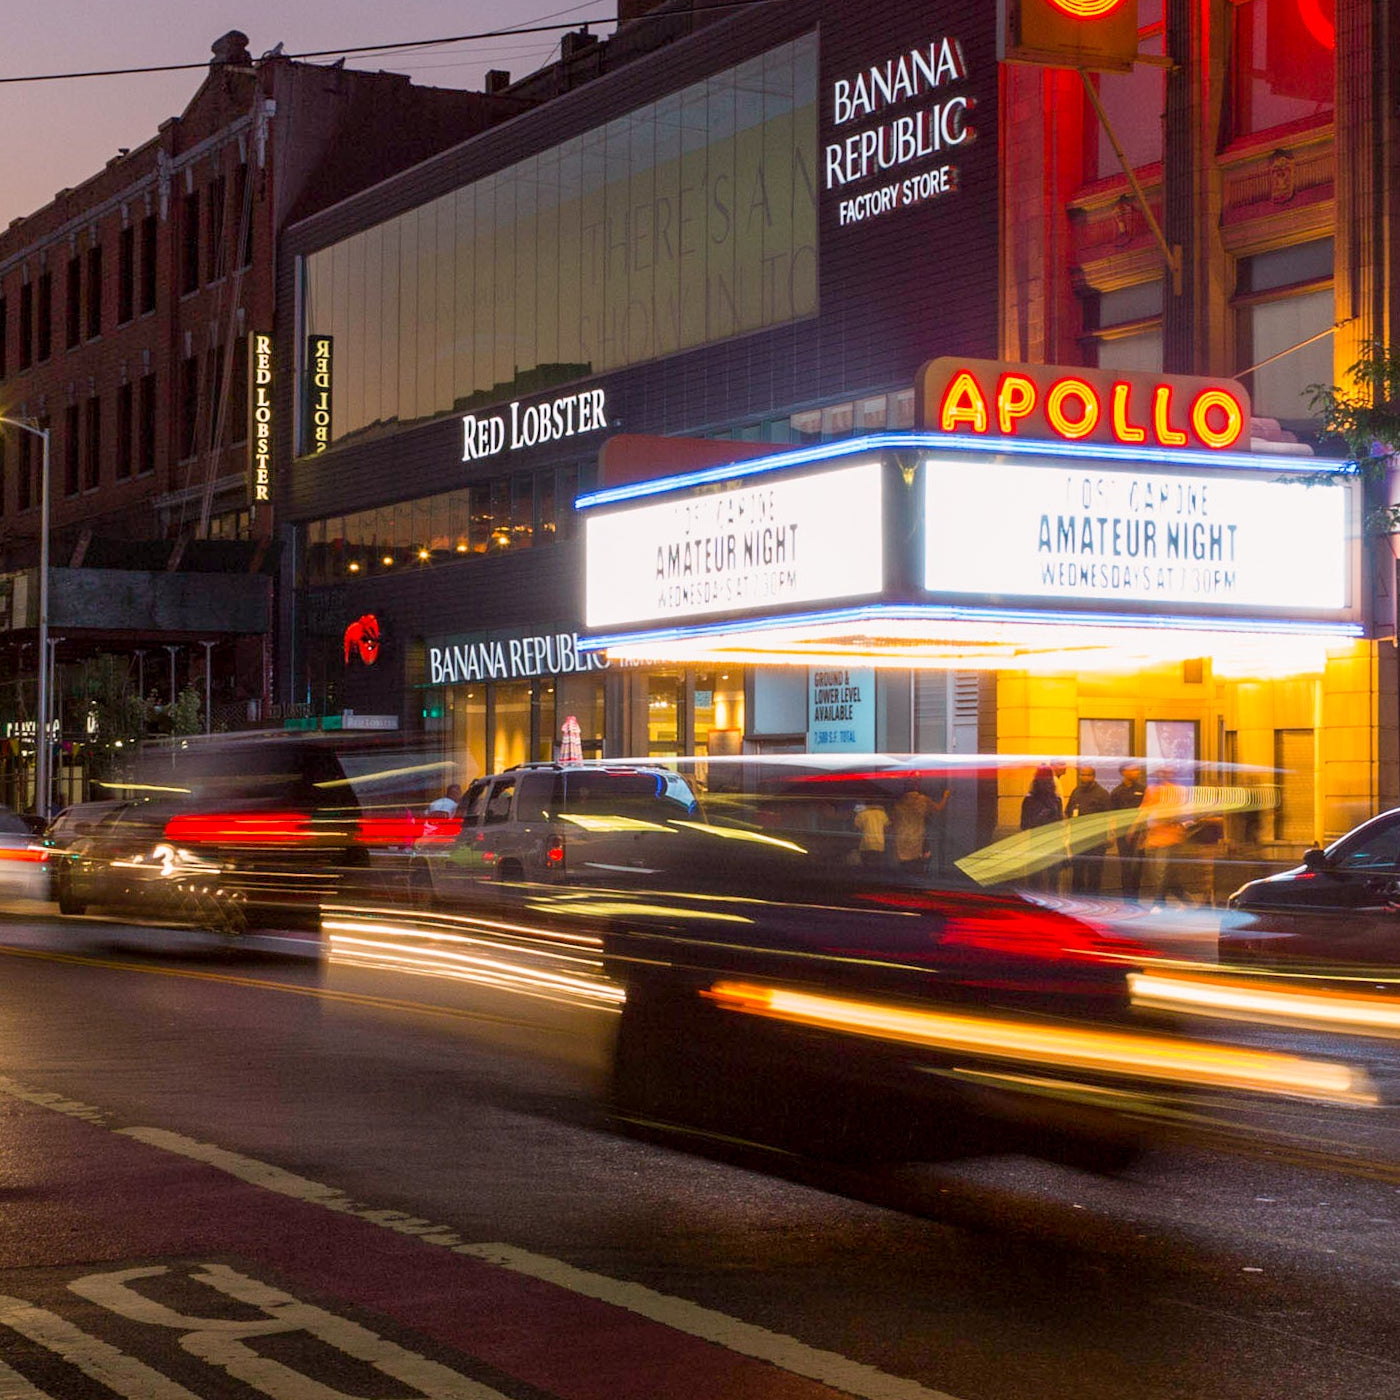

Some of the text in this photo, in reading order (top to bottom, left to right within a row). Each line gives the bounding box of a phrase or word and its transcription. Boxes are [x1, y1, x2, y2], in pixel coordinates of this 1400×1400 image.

[834, 37, 963, 125] BANANA
[826, 97, 970, 189] REPUBLIC
[840, 165, 952, 226] FACTORY STORE
[255, 335, 272, 501] RED LOBSTER
[462, 388, 607, 462] RED LOBSTER
[941, 369, 1243, 449] APOLLO
[655, 523, 798, 580] AMATEUR NIGHT
[1038, 513, 1238, 561] AMATEUR NIGHT
[657, 578, 733, 609] WEDNESDAS
[430, 641, 507, 684] BANANA
[814, 671, 843, 687] GROUND
[814, 686, 862, 704] LOWER LEVEL
[814, 704, 854, 721] AVAILABLE
